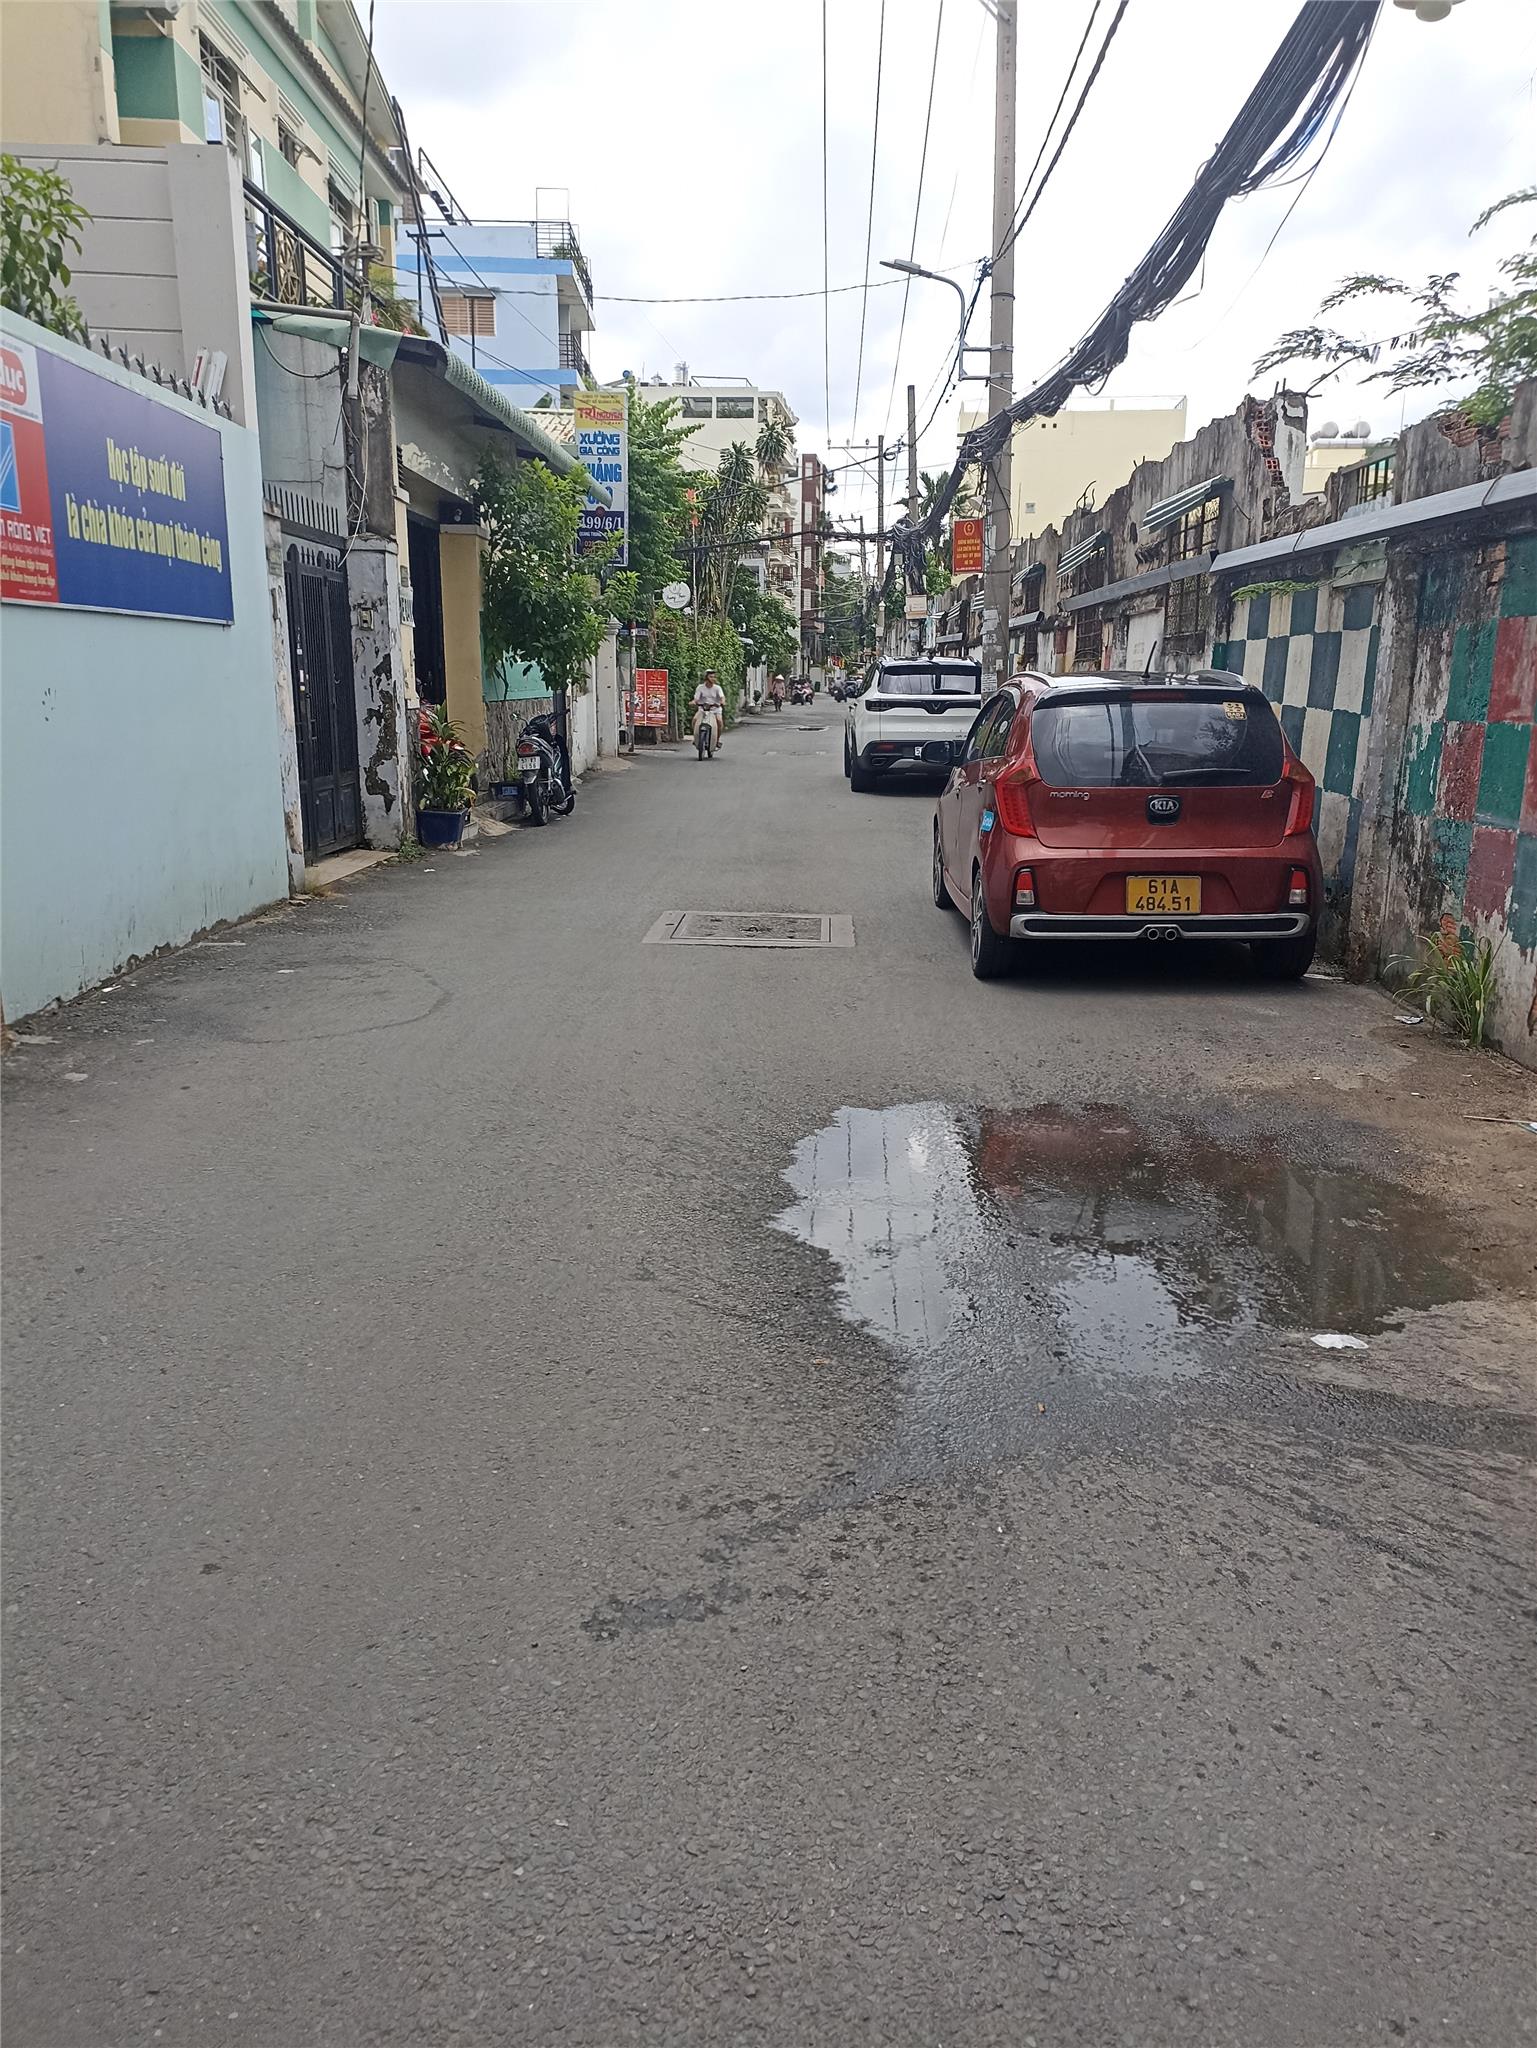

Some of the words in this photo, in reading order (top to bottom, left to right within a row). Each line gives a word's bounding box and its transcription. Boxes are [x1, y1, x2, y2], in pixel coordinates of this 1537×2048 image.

[579, 430, 620, 445] XƯỞNG
[579, 447, 593, 456] GIA
[596, 445, 620, 456] CÔNG
[107, 438, 129, 492] Học
[129, 446, 148, 497] tập
[148, 455, 171, 497] suốt
[170, 461, 186, 502] đời
[585, 457, 623, 482] UẢNG
[65, 493, 80, 539] là
[81, 500, 108, 545] chìa
[107, 504, 136, 550] khóa
[136, 507, 156, 553] của
[156, 520, 175, 566] mọi
[175, 522, 201, 564] thành
[201, 531, 222, 573] công
[1050, 791, 1090, 801] morning
[1154, 800, 1175, 810] KIA
[1148, 880, 1179, 894] 61A
[1136, 896, 1191, 911] 484.51
